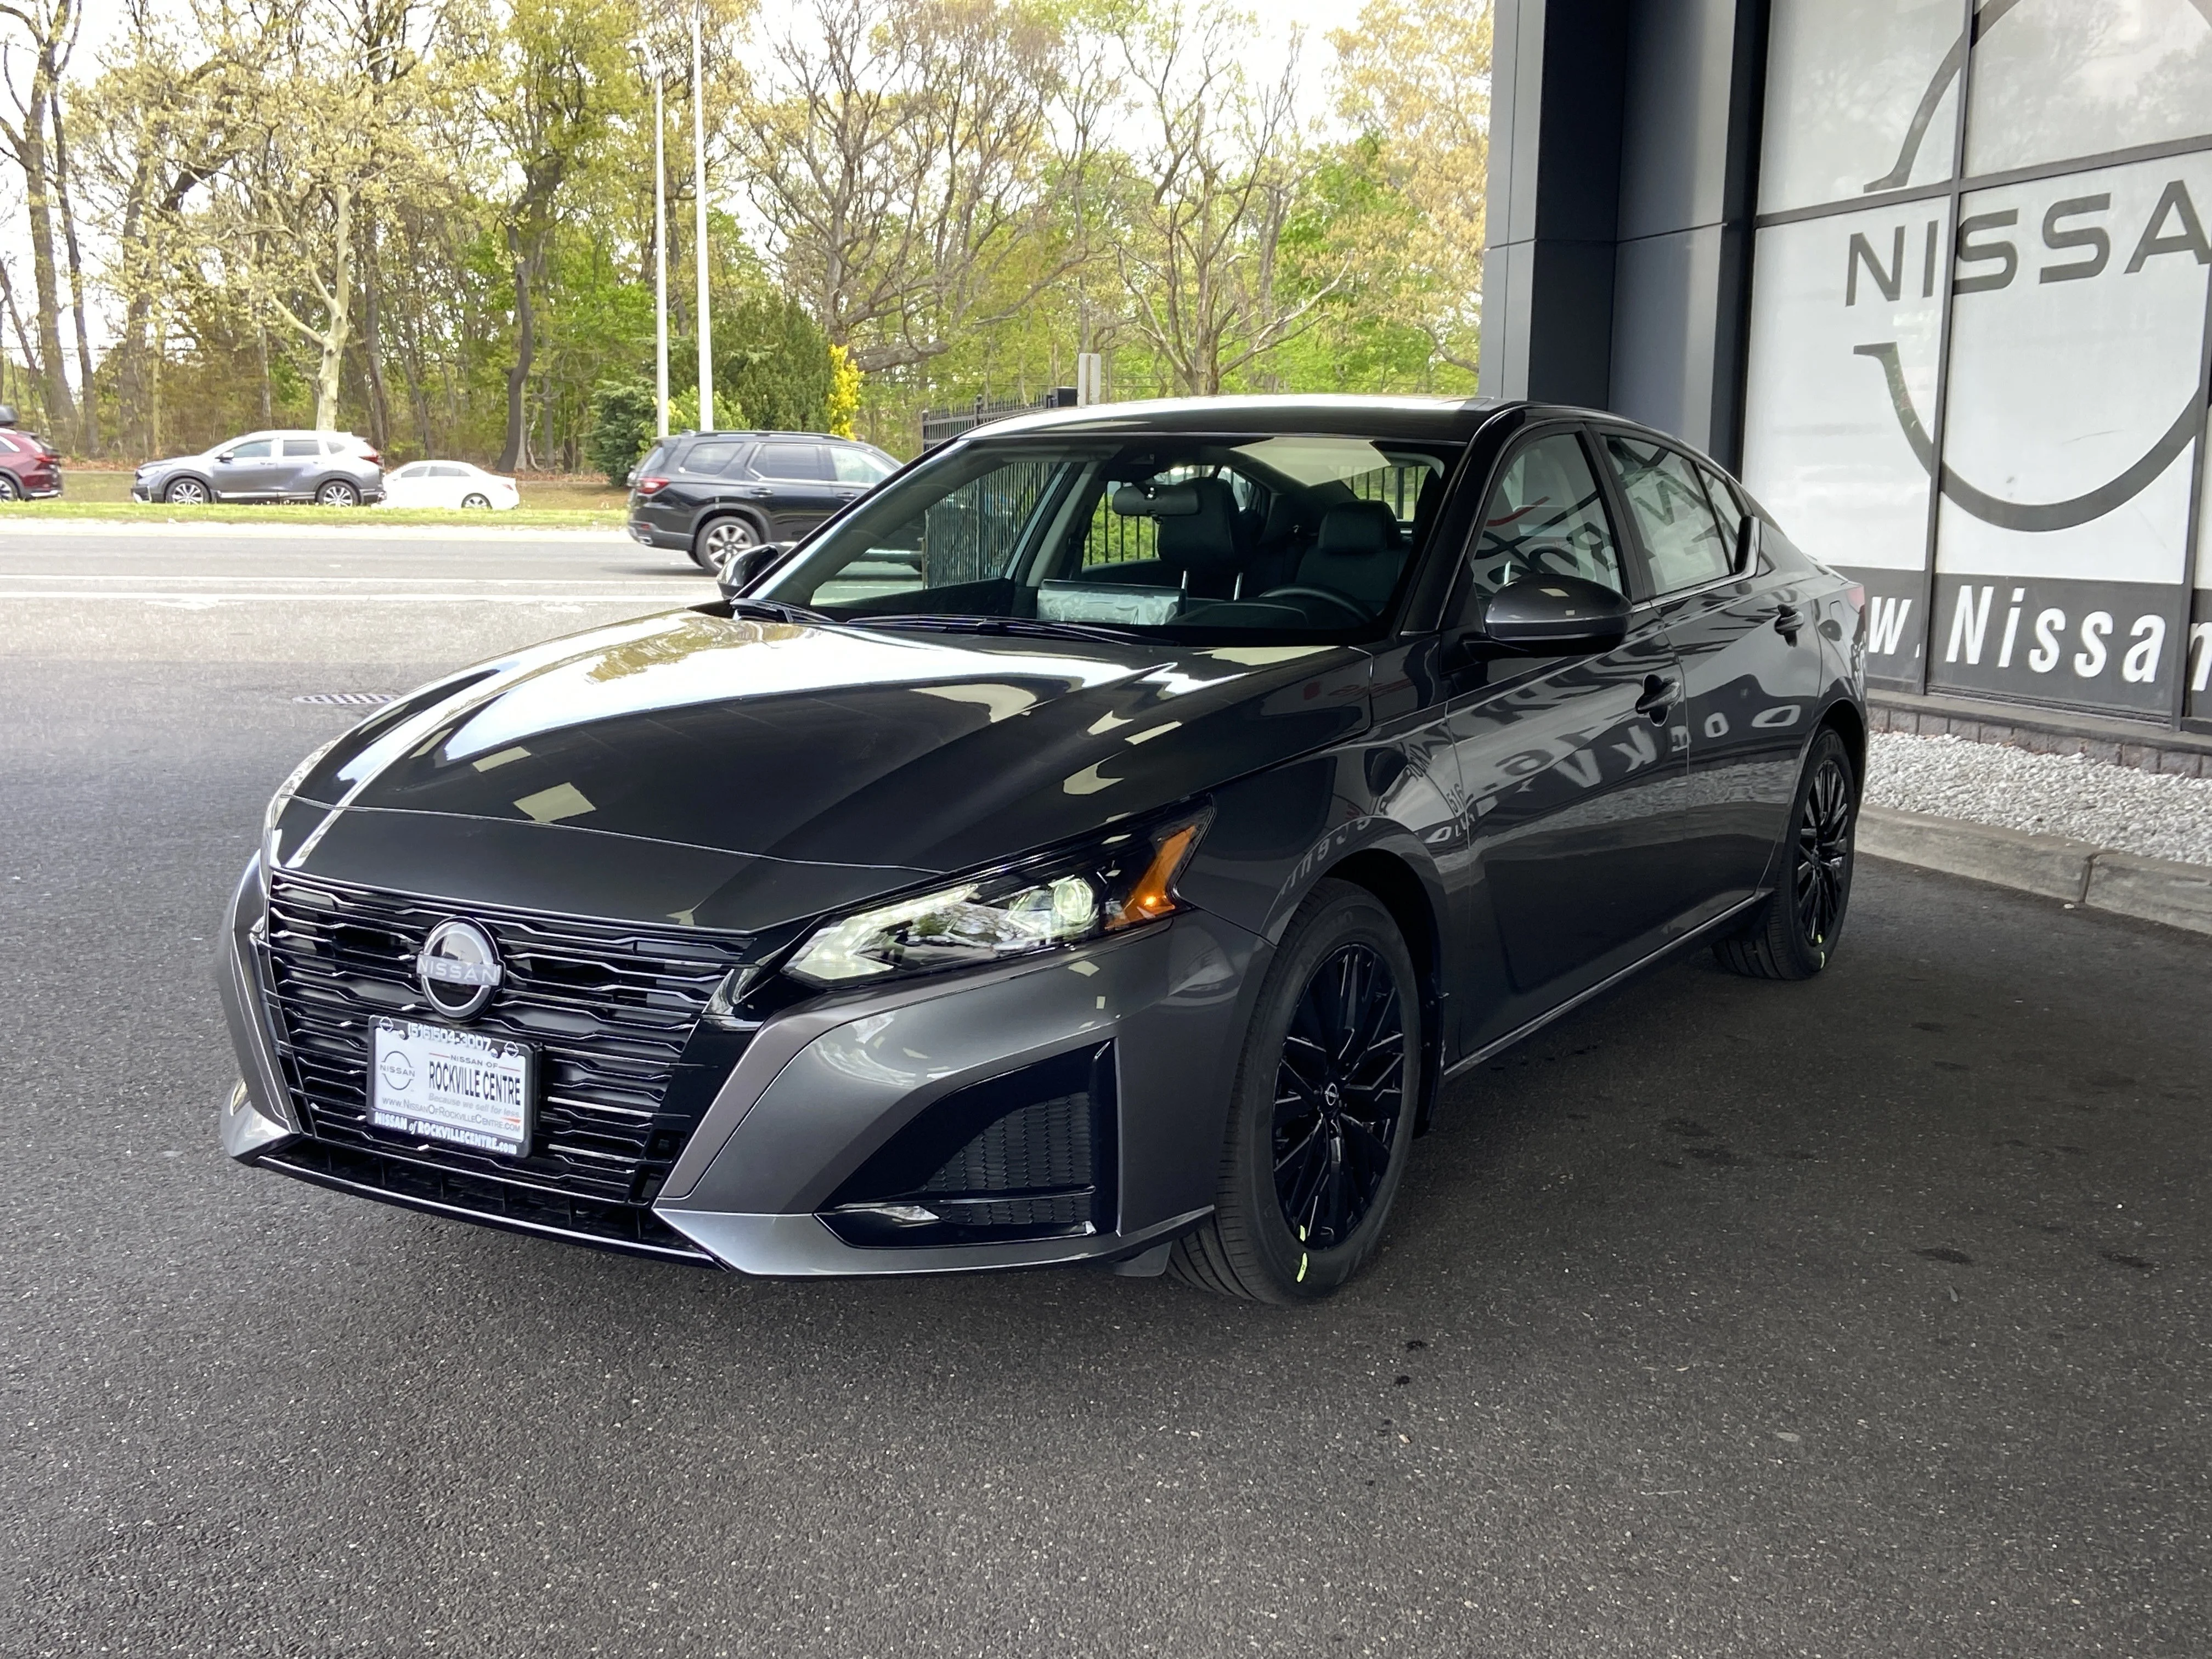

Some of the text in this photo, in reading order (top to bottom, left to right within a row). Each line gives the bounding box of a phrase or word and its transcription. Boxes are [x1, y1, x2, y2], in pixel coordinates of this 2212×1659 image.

[1845, 179, 2212, 308] NISSA
[417, 958, 498, 983] NISSAN
[380, 1064, 415, 1077] NISSAN
[450, 1054, 483, 1066] NISSAN
[428, 1061, 521, 1106] ROCKVILLE CENTRE
[428, 1093, 461, 1107] Because
[475, 1103, 489, 1112] sell
[490, 1107, 501, 1115] for
[375, 1111, 408, 1130] NISSAN
[409, 1120, 418, 1135] of
